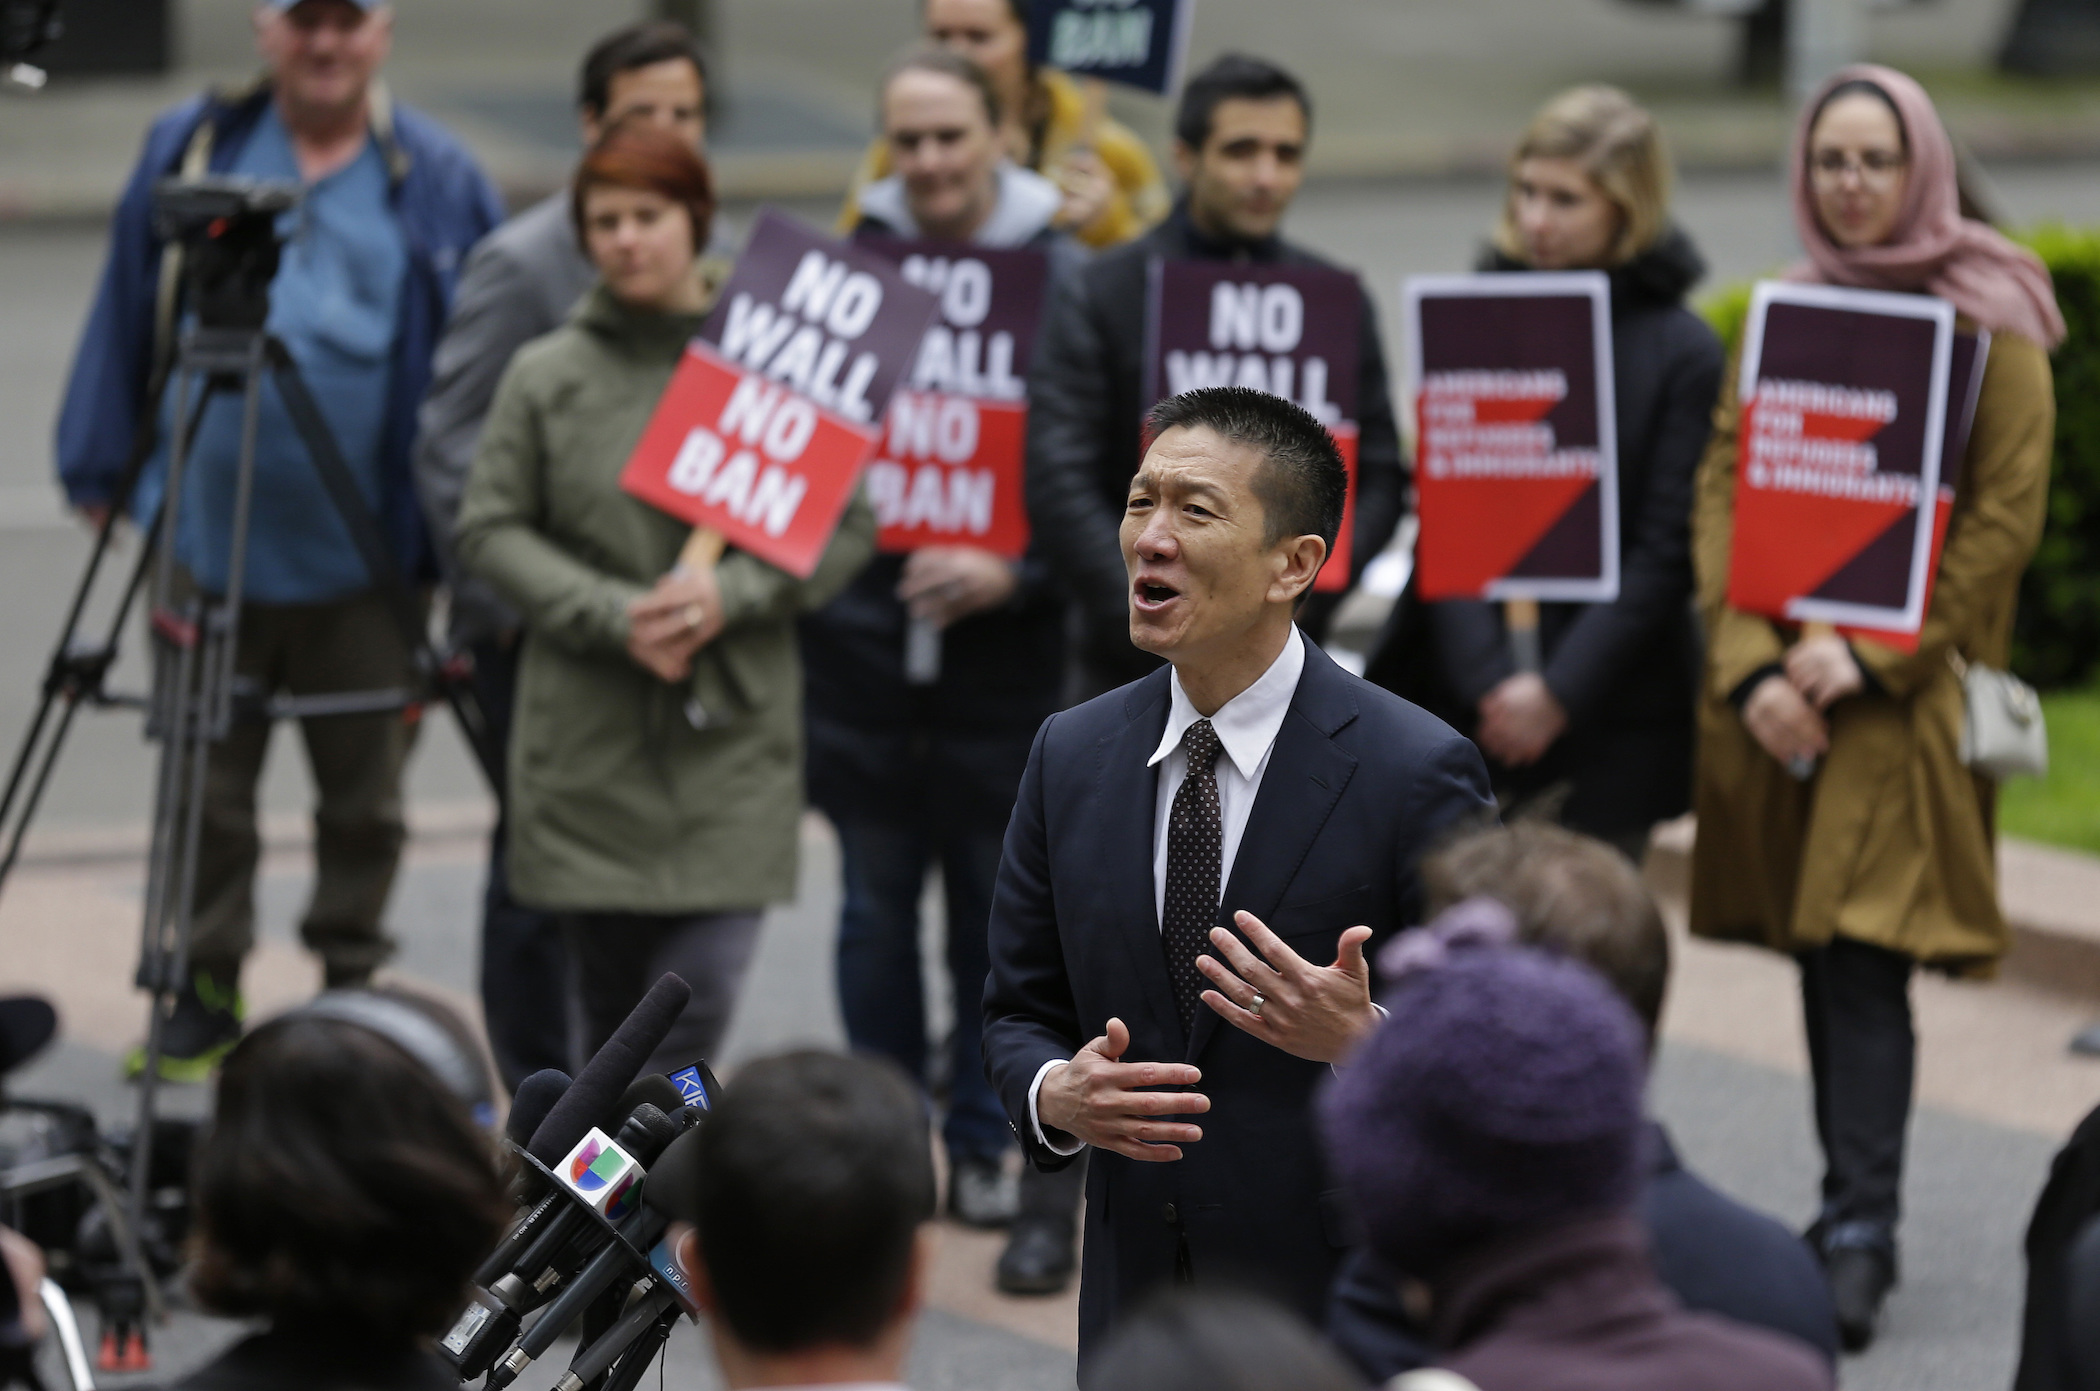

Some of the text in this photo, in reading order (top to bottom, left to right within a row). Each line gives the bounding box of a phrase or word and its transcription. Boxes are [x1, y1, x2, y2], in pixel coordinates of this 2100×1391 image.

[783, 249, 883, 339] NO
[1208, 281, 1303, 354] NO
[719, 291, 878, 424] WALL
[909, 327, 1028, 396] ALL
[717, 373, 819, 463] NO
[888, 396, 980, 463] NO
[1755, 377, 1897, 422] AMERICANS
[667, 427, 807, 538] BAN
[866, 461, 994, 534] BAN
[666, 1265, 689, 1288] npr
